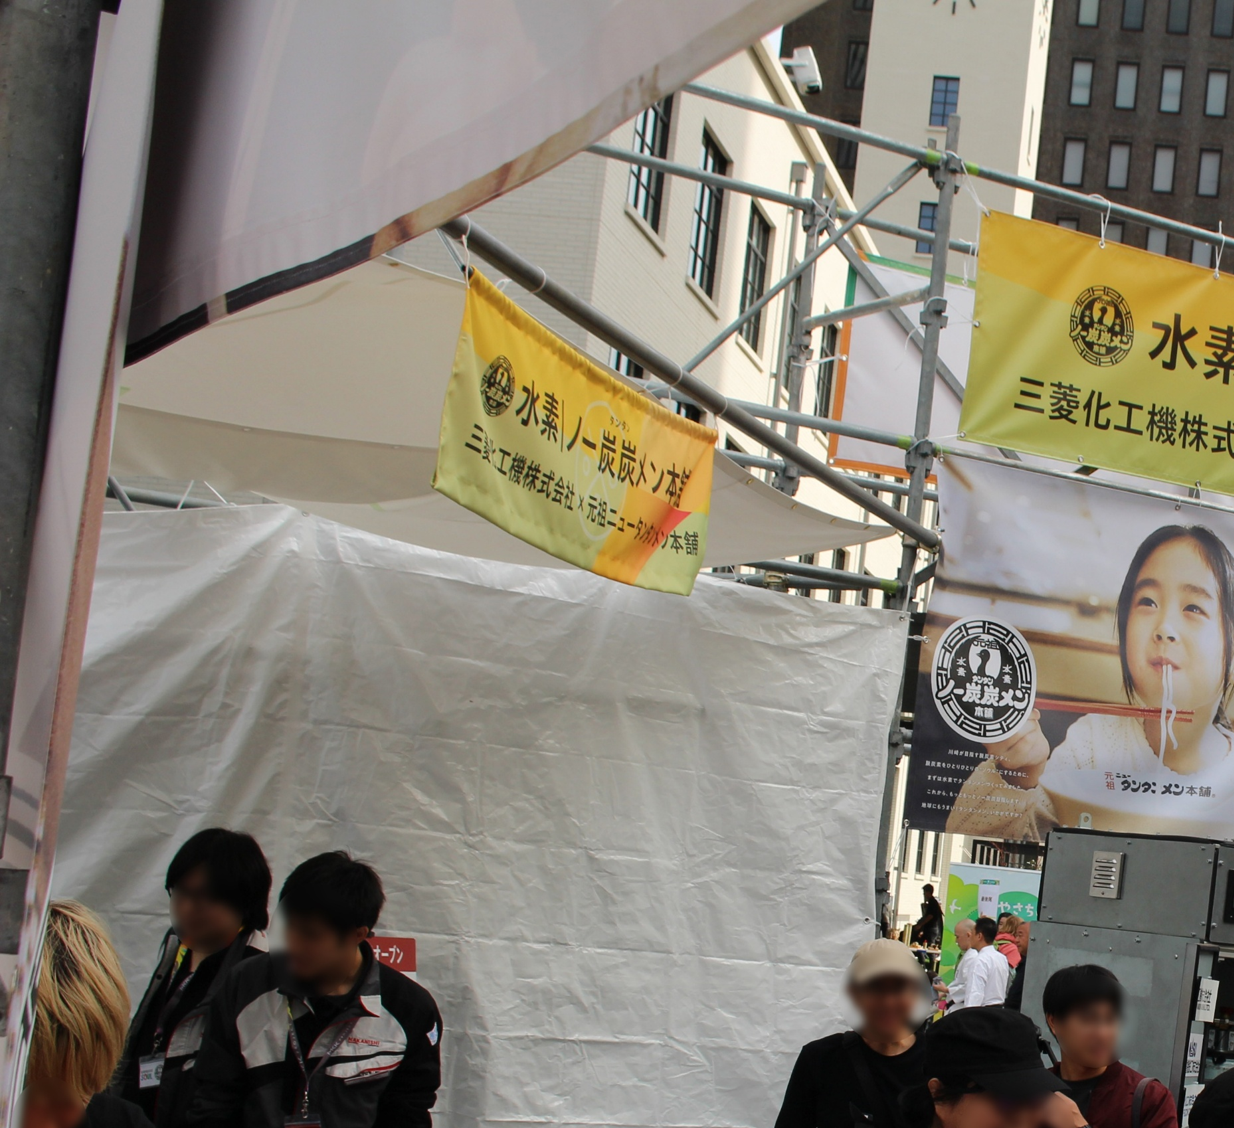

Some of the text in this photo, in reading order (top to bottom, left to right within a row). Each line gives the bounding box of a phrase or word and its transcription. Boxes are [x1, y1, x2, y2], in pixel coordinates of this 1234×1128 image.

[465, 423, 575, 511] 三菱工機株式会社
[972, 674, 994, 685] タンタン
[935, 679, 1030, 710] ノー炭炭メン
[1104, 771, 1116, 791] 元祖
